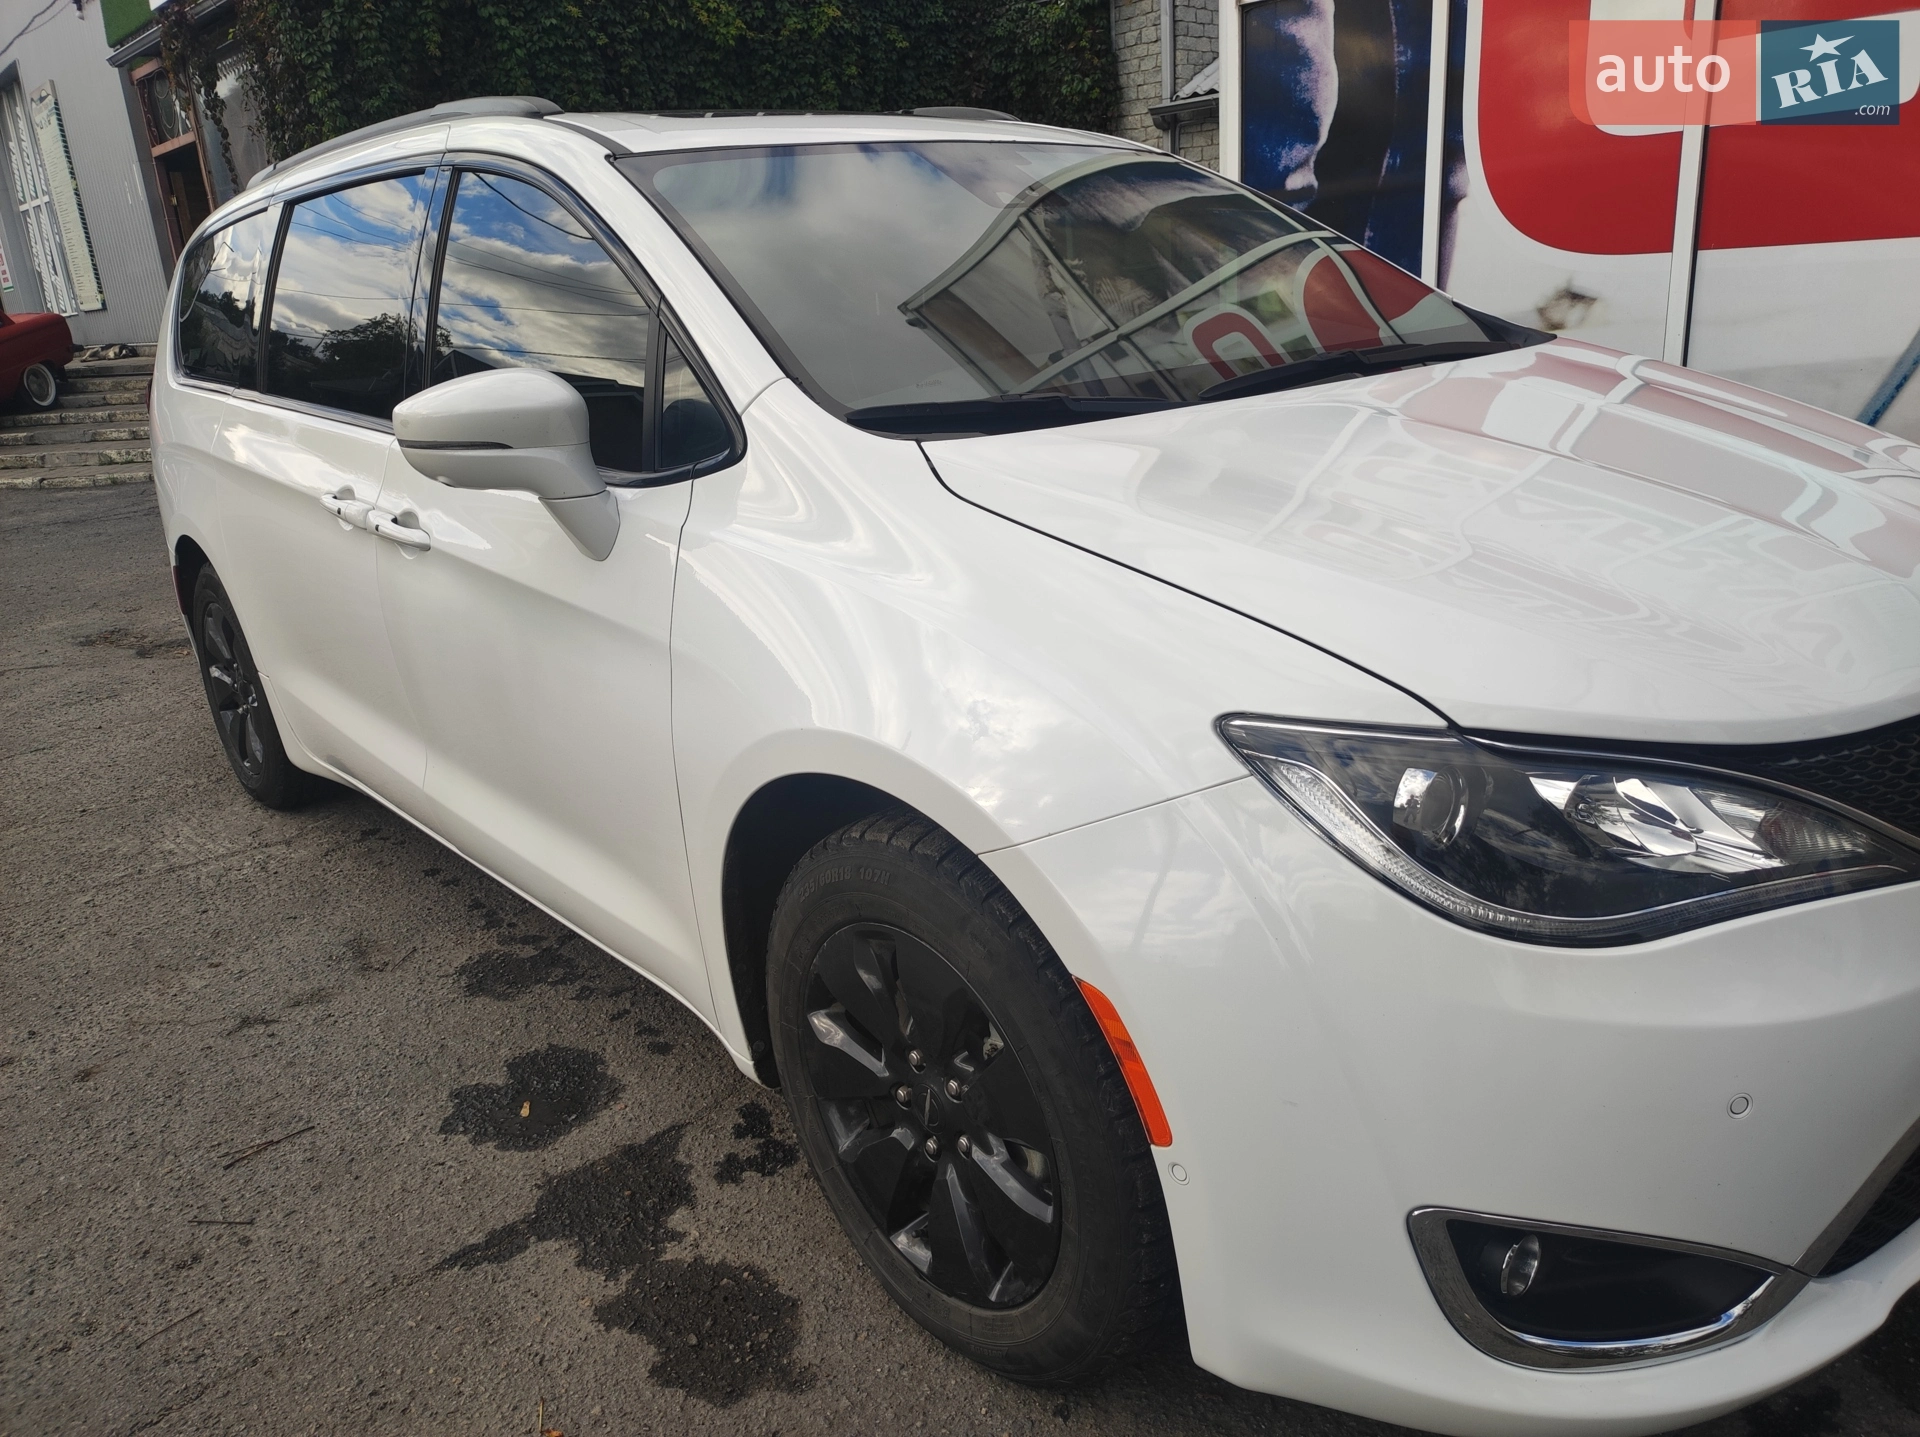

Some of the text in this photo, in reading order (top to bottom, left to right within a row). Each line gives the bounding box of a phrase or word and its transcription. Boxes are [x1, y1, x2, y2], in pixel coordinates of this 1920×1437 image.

[9, 141, 24, 202] МОЙКА
[799, 865, 891, 902] 235/60R18 107H
